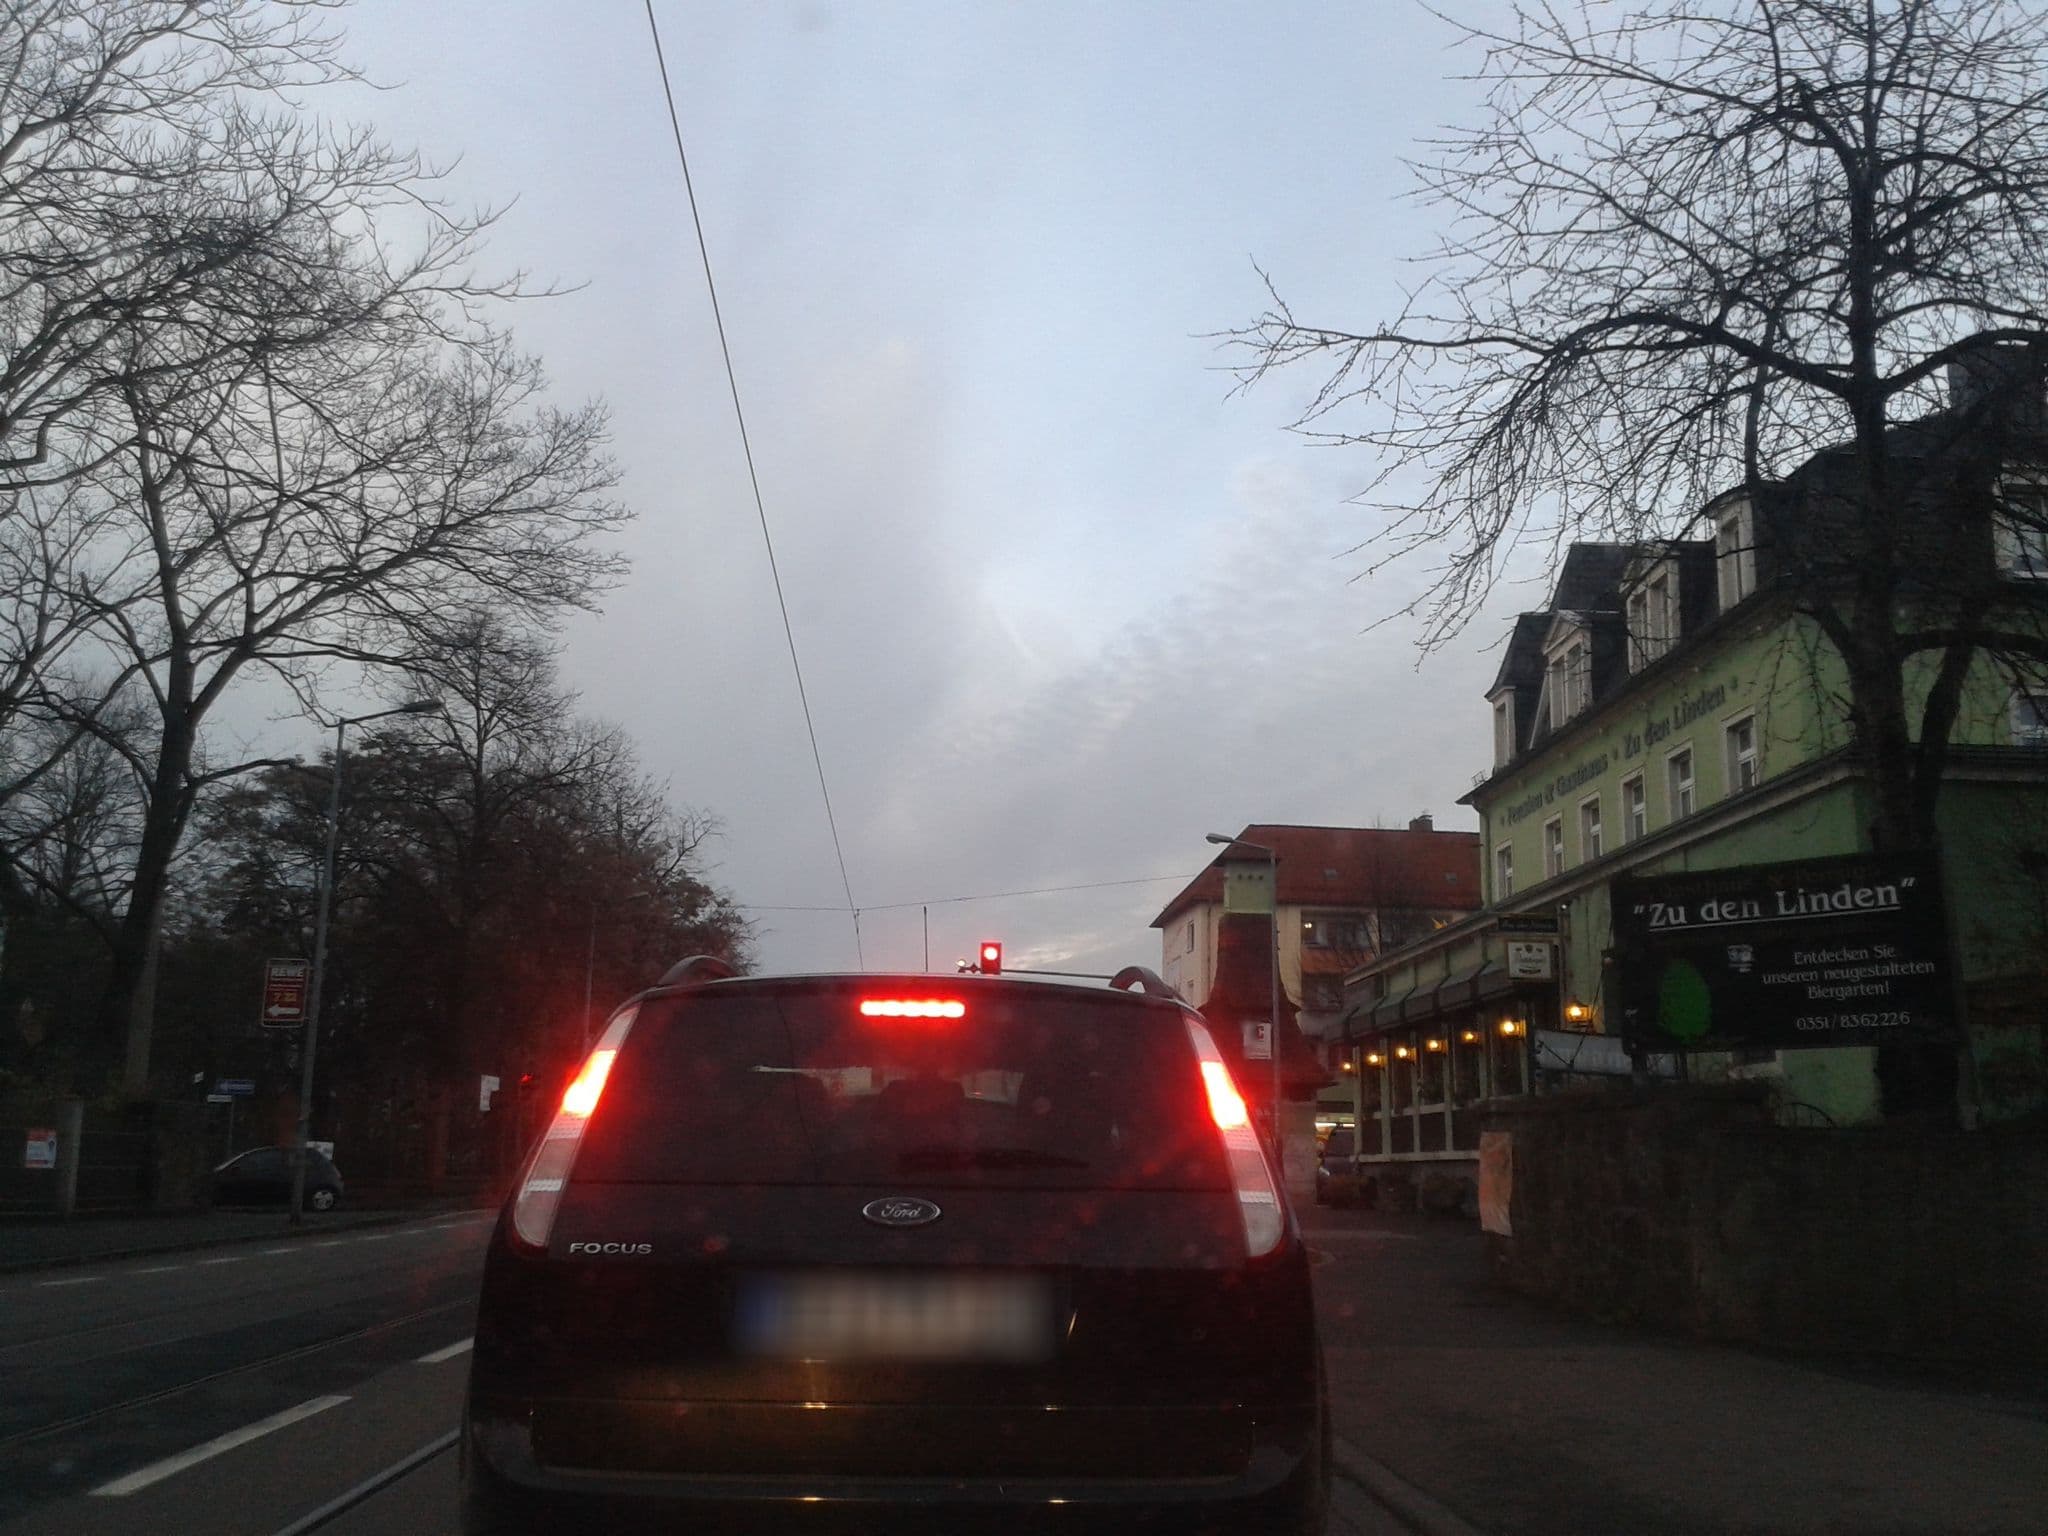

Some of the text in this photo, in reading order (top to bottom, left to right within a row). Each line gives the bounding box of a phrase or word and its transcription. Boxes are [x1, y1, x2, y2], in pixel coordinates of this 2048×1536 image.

[1700, 899, 1760, 921] den
[1793, 945, 1897, 965] Entdecken Sie
[1761, 960, 1936, 985] unseren neugestalteten
[1807, 981, 1890, 1001] Biergarten!
[881, 1202, 921, 1219] Ford
[569, 1242, 653, 1255] FOCUS
